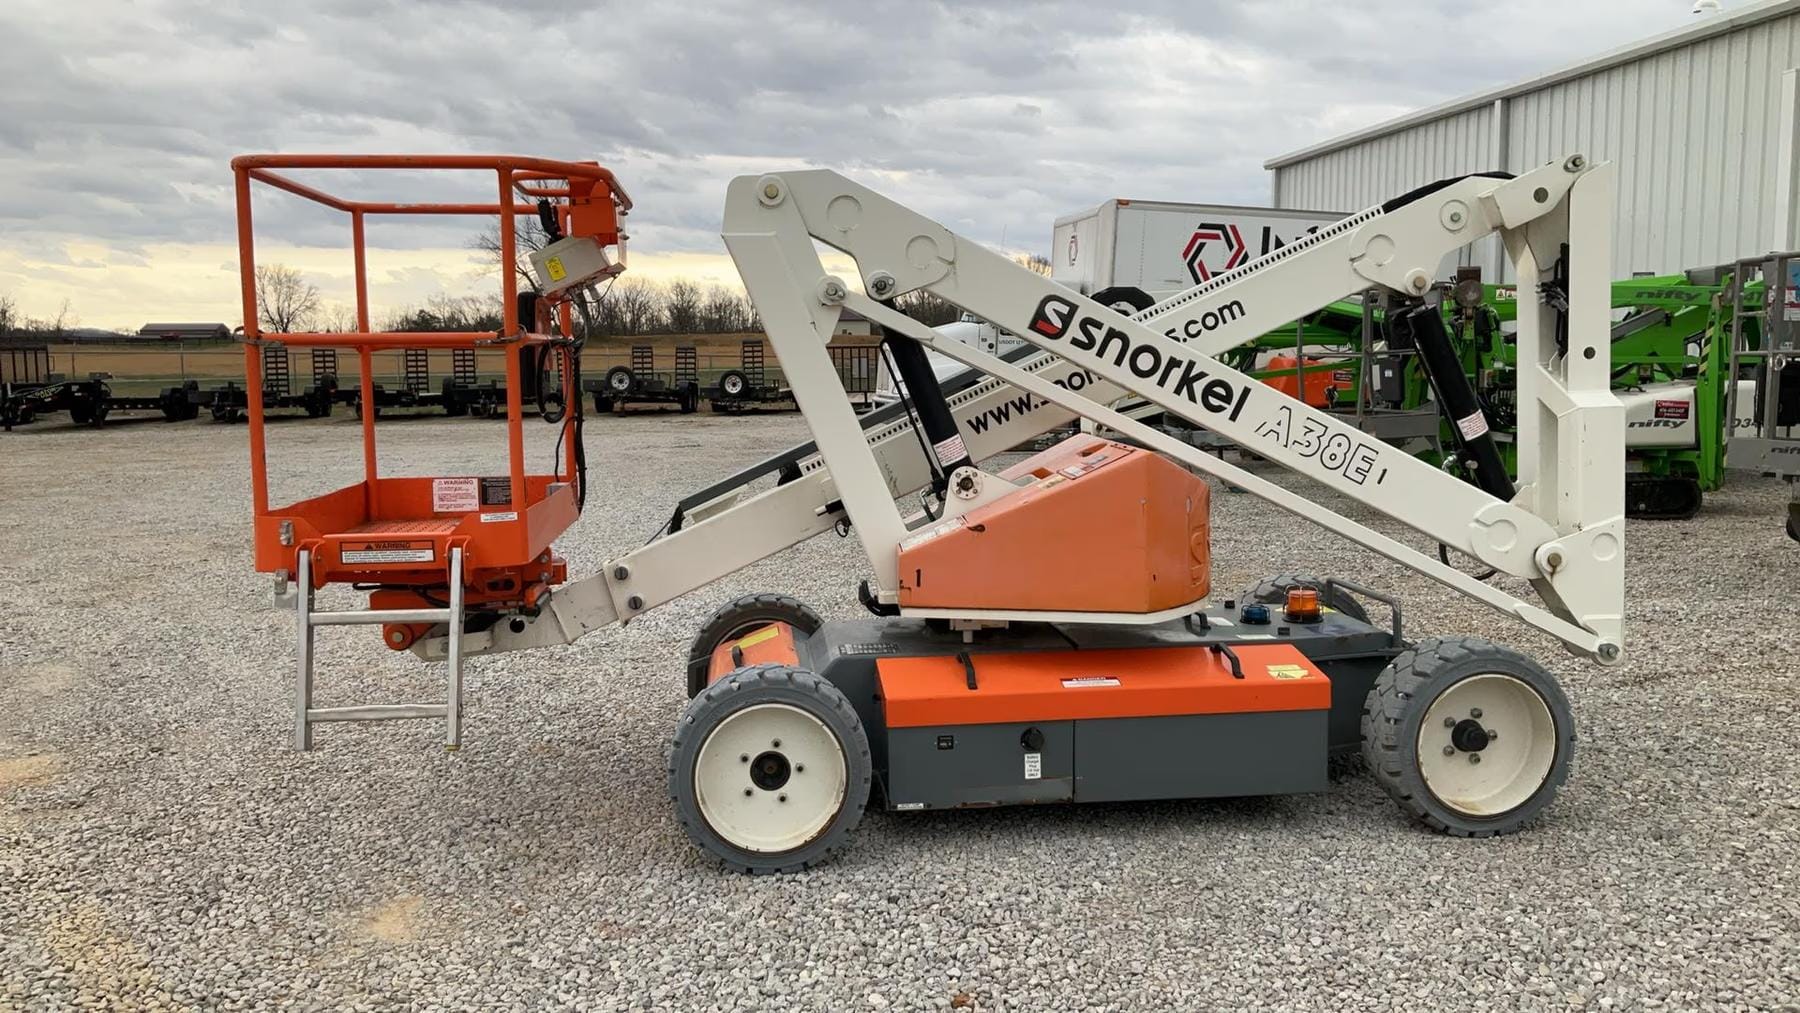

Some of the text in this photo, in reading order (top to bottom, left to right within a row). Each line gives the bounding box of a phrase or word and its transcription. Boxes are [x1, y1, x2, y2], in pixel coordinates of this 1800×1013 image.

[1070, 316, 1252, 422] snorkel
[1254, 405, 1379, 485] A38E
[1628, 419, 1687, 429] nifty
